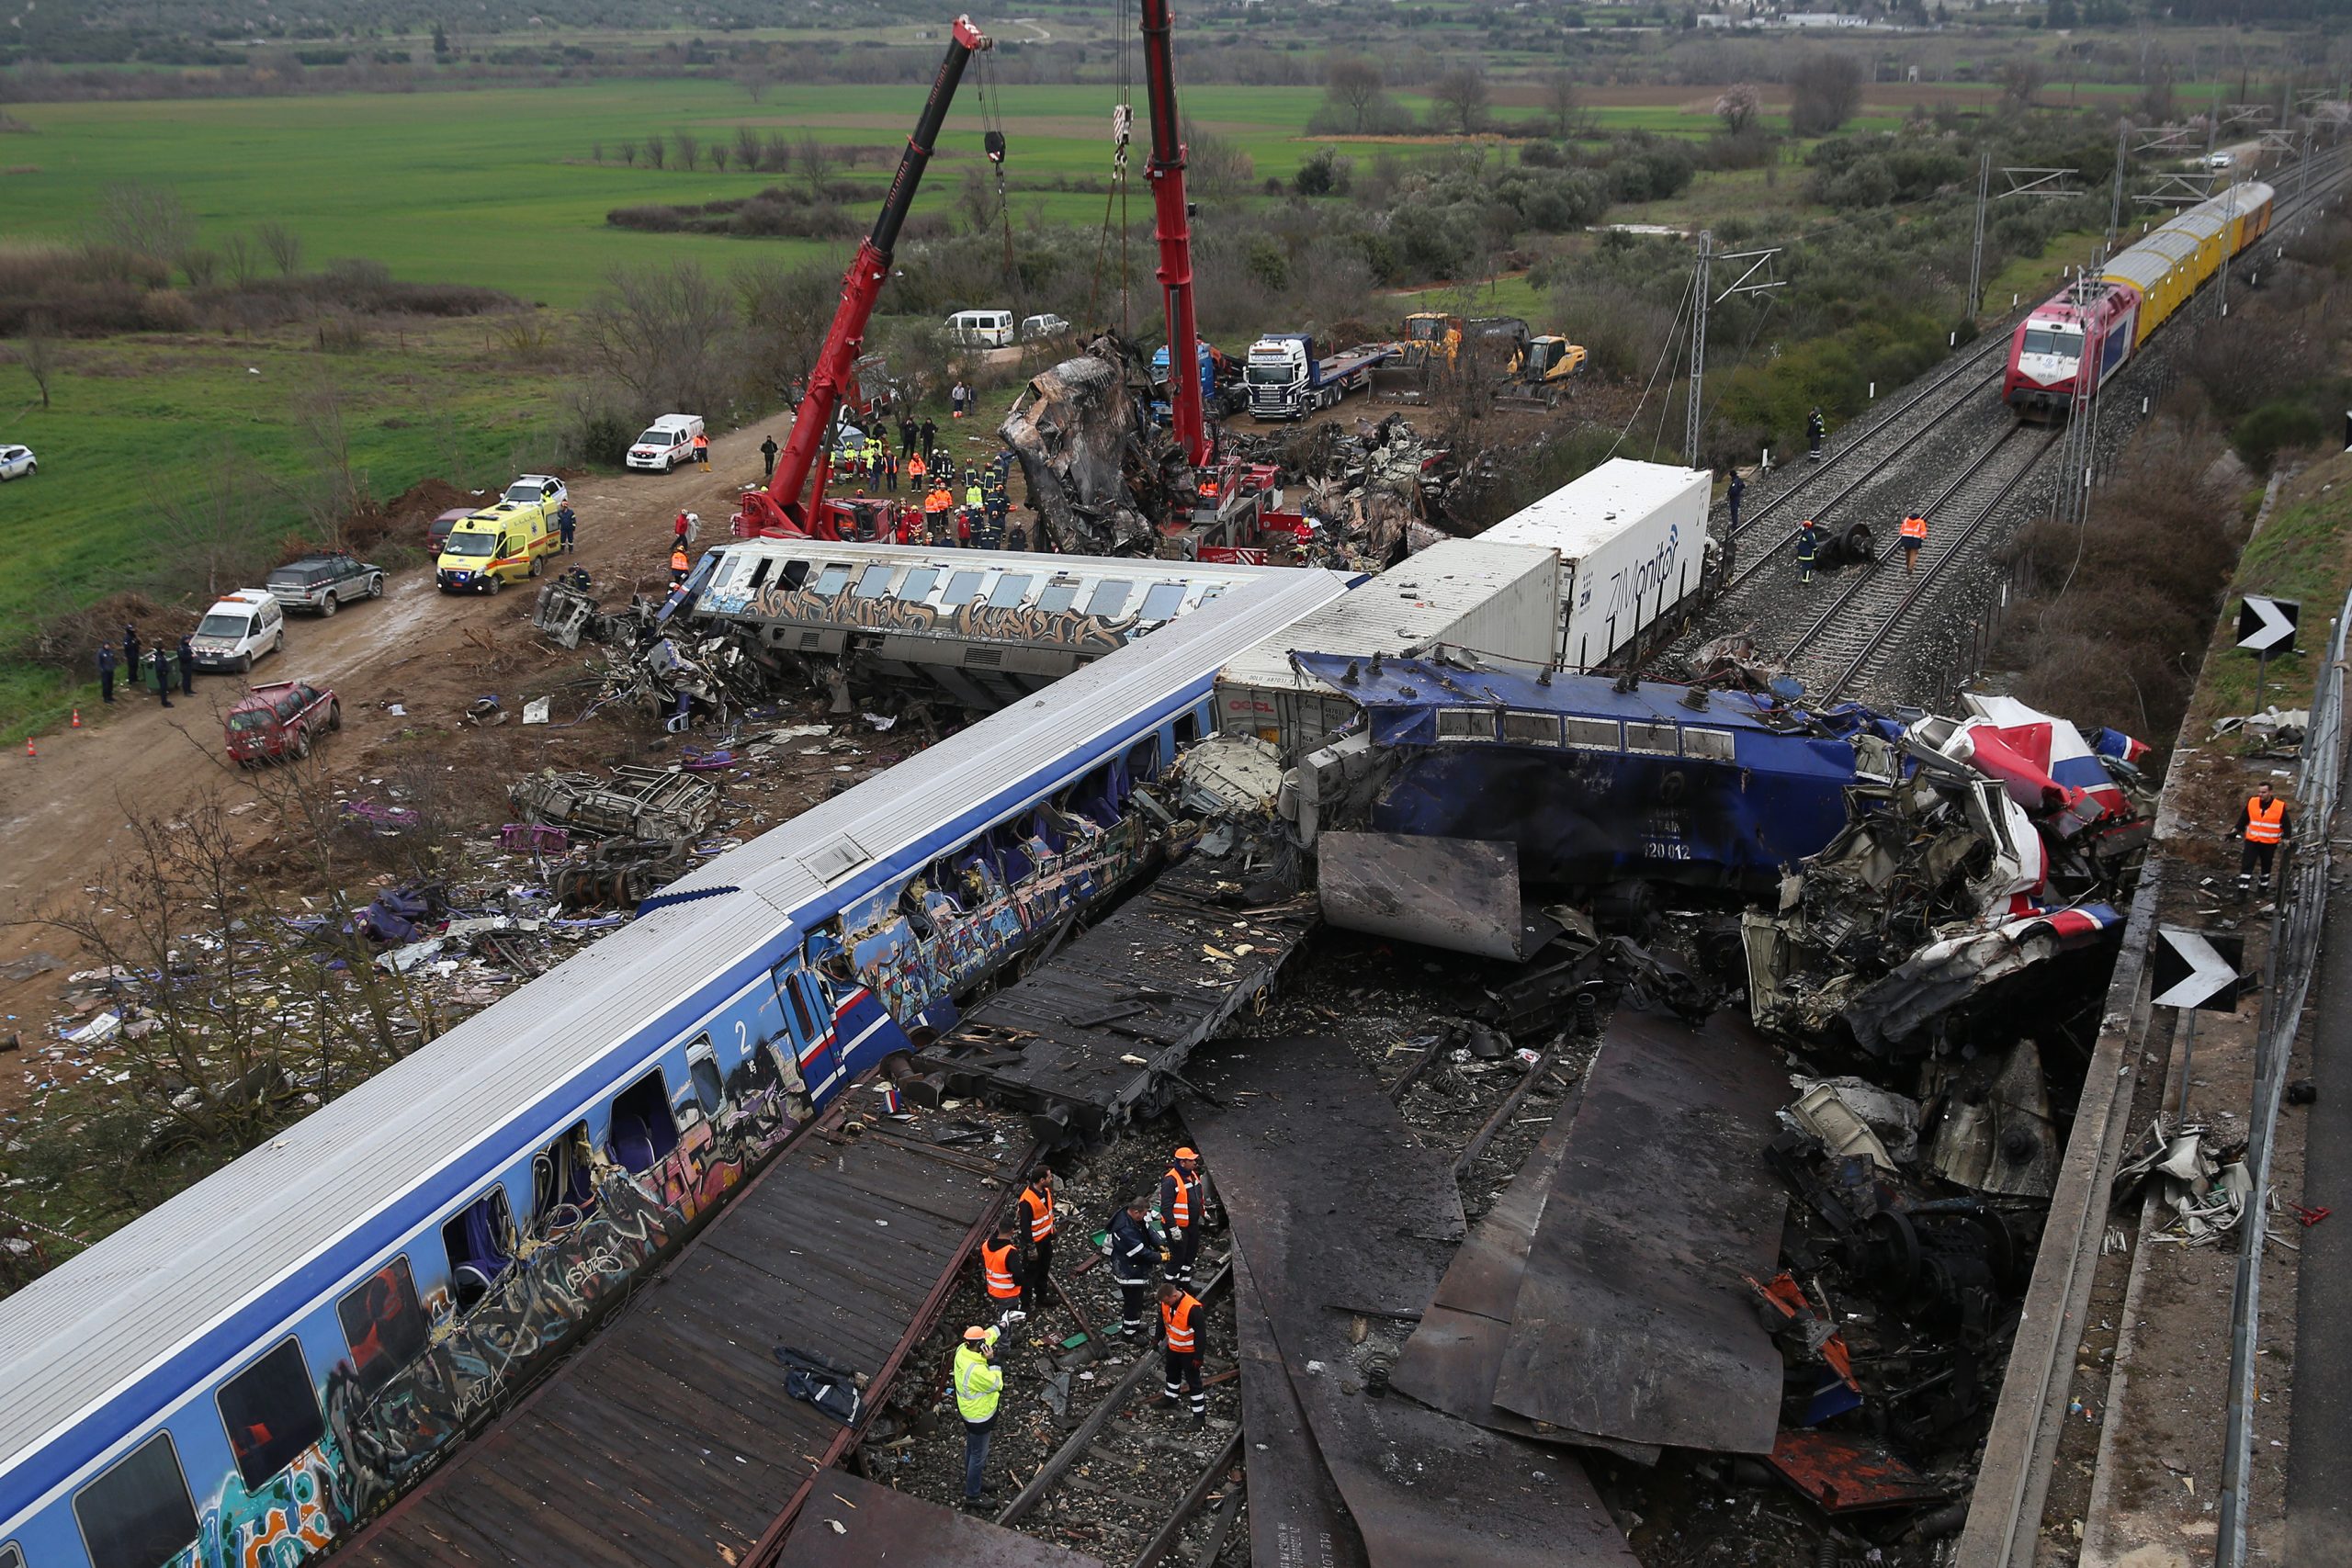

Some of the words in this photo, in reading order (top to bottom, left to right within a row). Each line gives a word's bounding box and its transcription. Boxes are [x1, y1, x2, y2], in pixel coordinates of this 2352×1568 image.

[1605, 538, 1679, 623] ZIMonitor
[1580, 588, 1591, 608] ZIM
[1668, 844, 1690, 860] 012
[735, 1021, 752, 1055] 2
